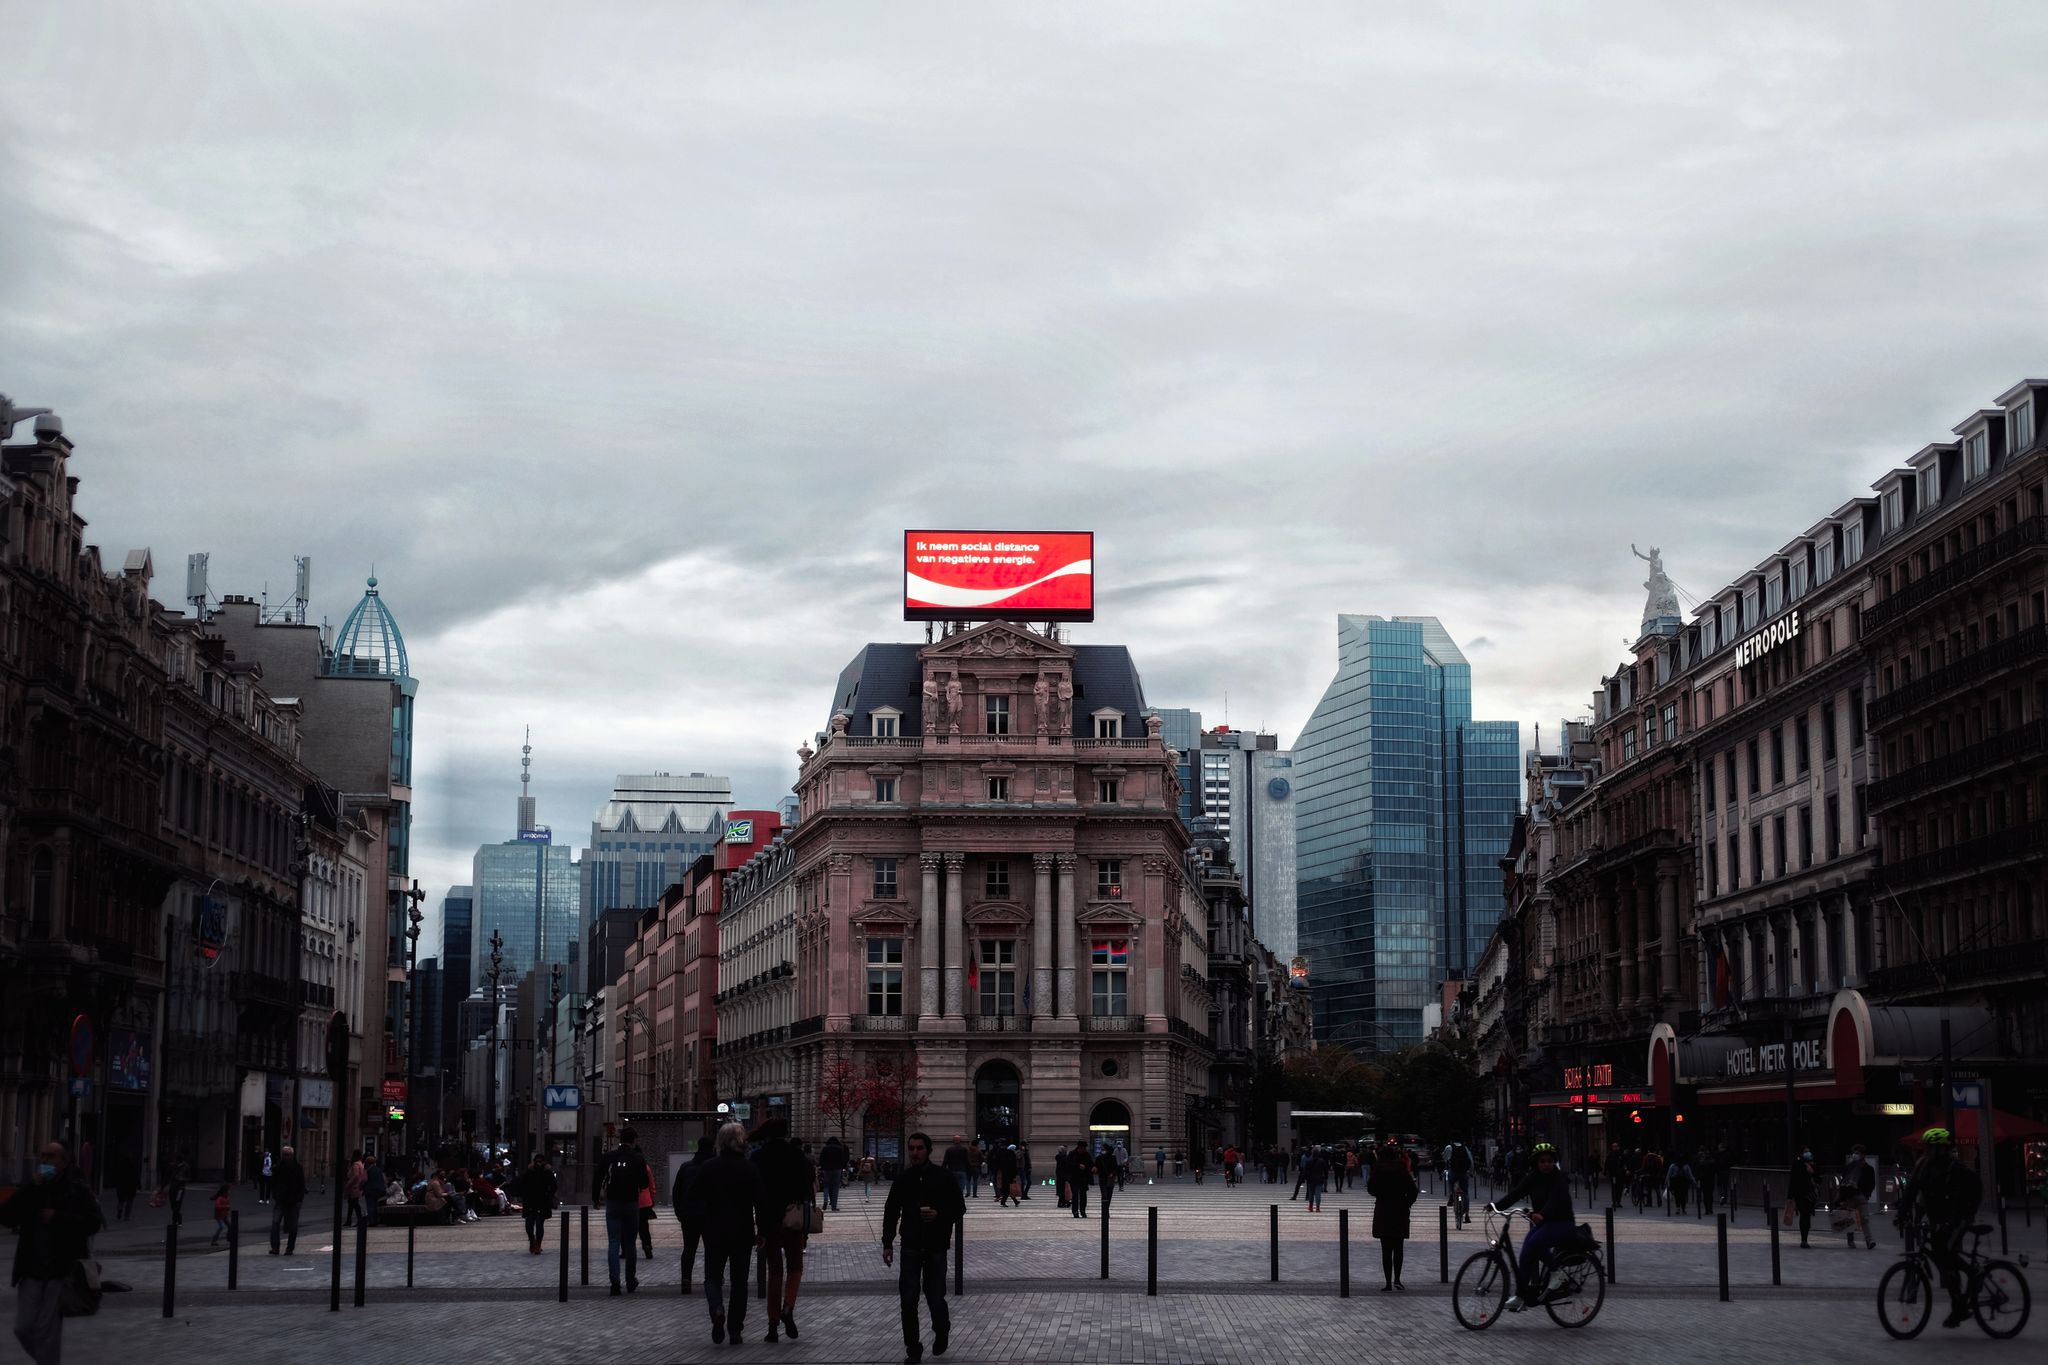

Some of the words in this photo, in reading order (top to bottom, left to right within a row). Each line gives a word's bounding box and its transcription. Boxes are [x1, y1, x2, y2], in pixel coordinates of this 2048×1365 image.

[916, 542, 927, 551] Ik
[929, 543, 959, 551] neem
[961, 542, 992, 551] social
[994, 542, 1040, 552] distance
[916, 555, 936, 563] van
[938, 554, 990, 565] negatieve
[992, 555, 1035, 566] energie.
[1735, 610, 1799, 670] METROPOLE
[1726, 1047, 1756, 1076] HOTEL
[1759, 1039, 1820, 1073] METRPOLE
